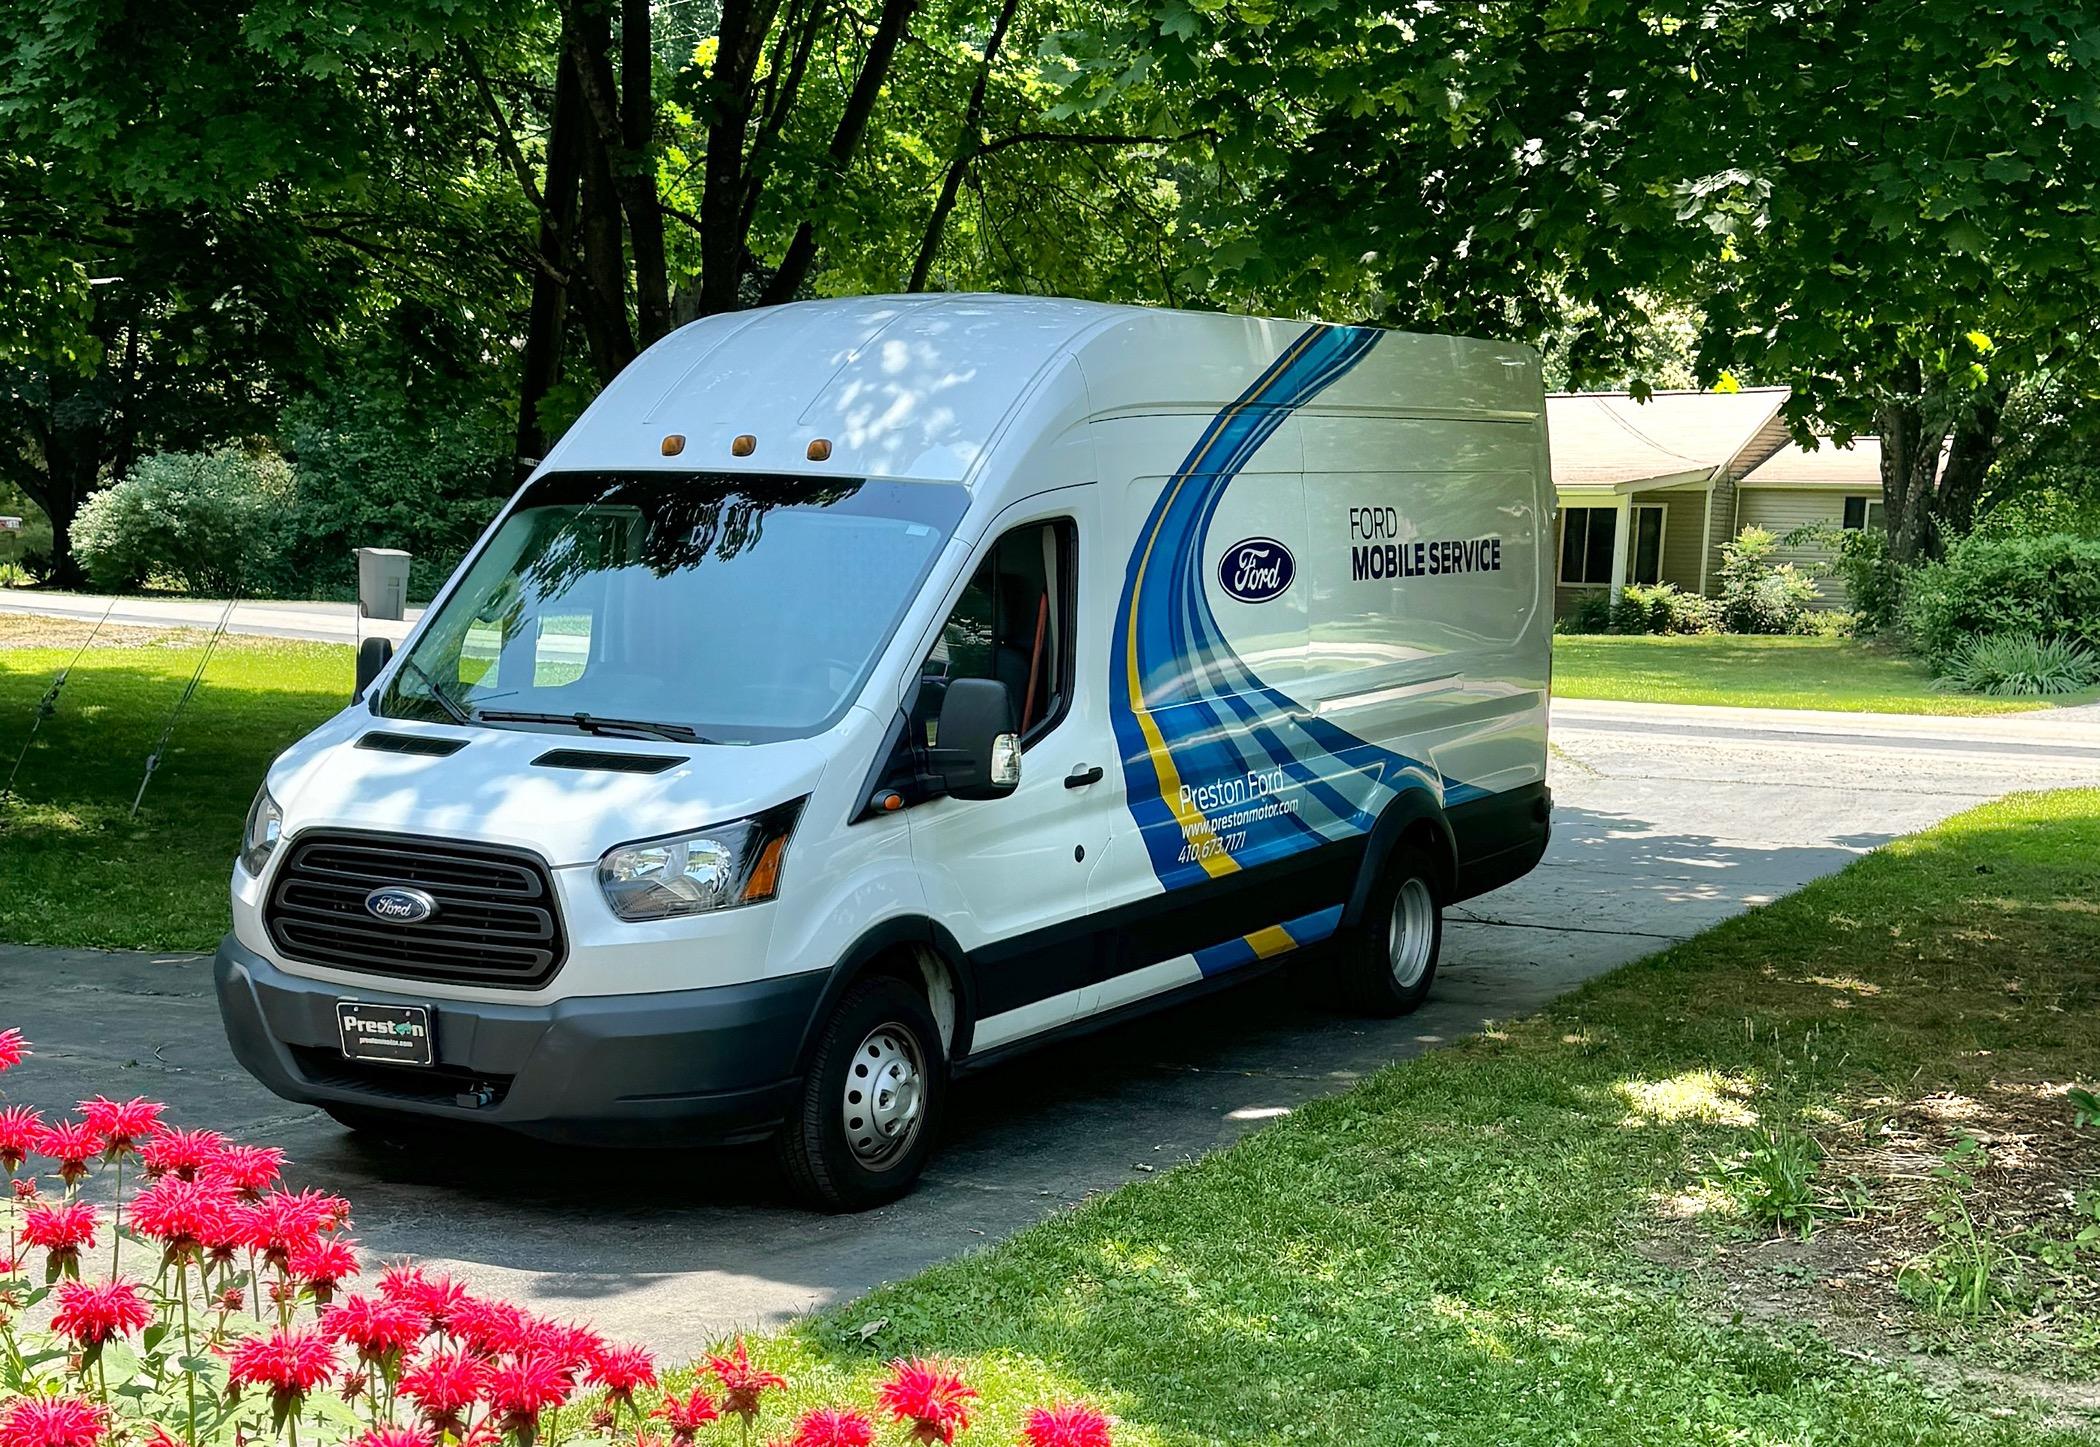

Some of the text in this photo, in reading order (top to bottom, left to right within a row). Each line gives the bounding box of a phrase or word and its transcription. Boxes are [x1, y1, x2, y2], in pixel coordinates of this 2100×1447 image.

[1349, 507, 1397, 540] FORD
[1234, 548, 1281, 592] Ford
[1352, 539, 1501, 581] MOBILE SERVICE
[1179, 763, 1284, 814] Preston Ford
[1181, 798, 1299, 839] www.prestonmotor.com
[1177, 831, 1247, 864] 410.673.7171
[376, 895, 412, 917] Ford
[343, 1015, 425, 1037] Prestn
